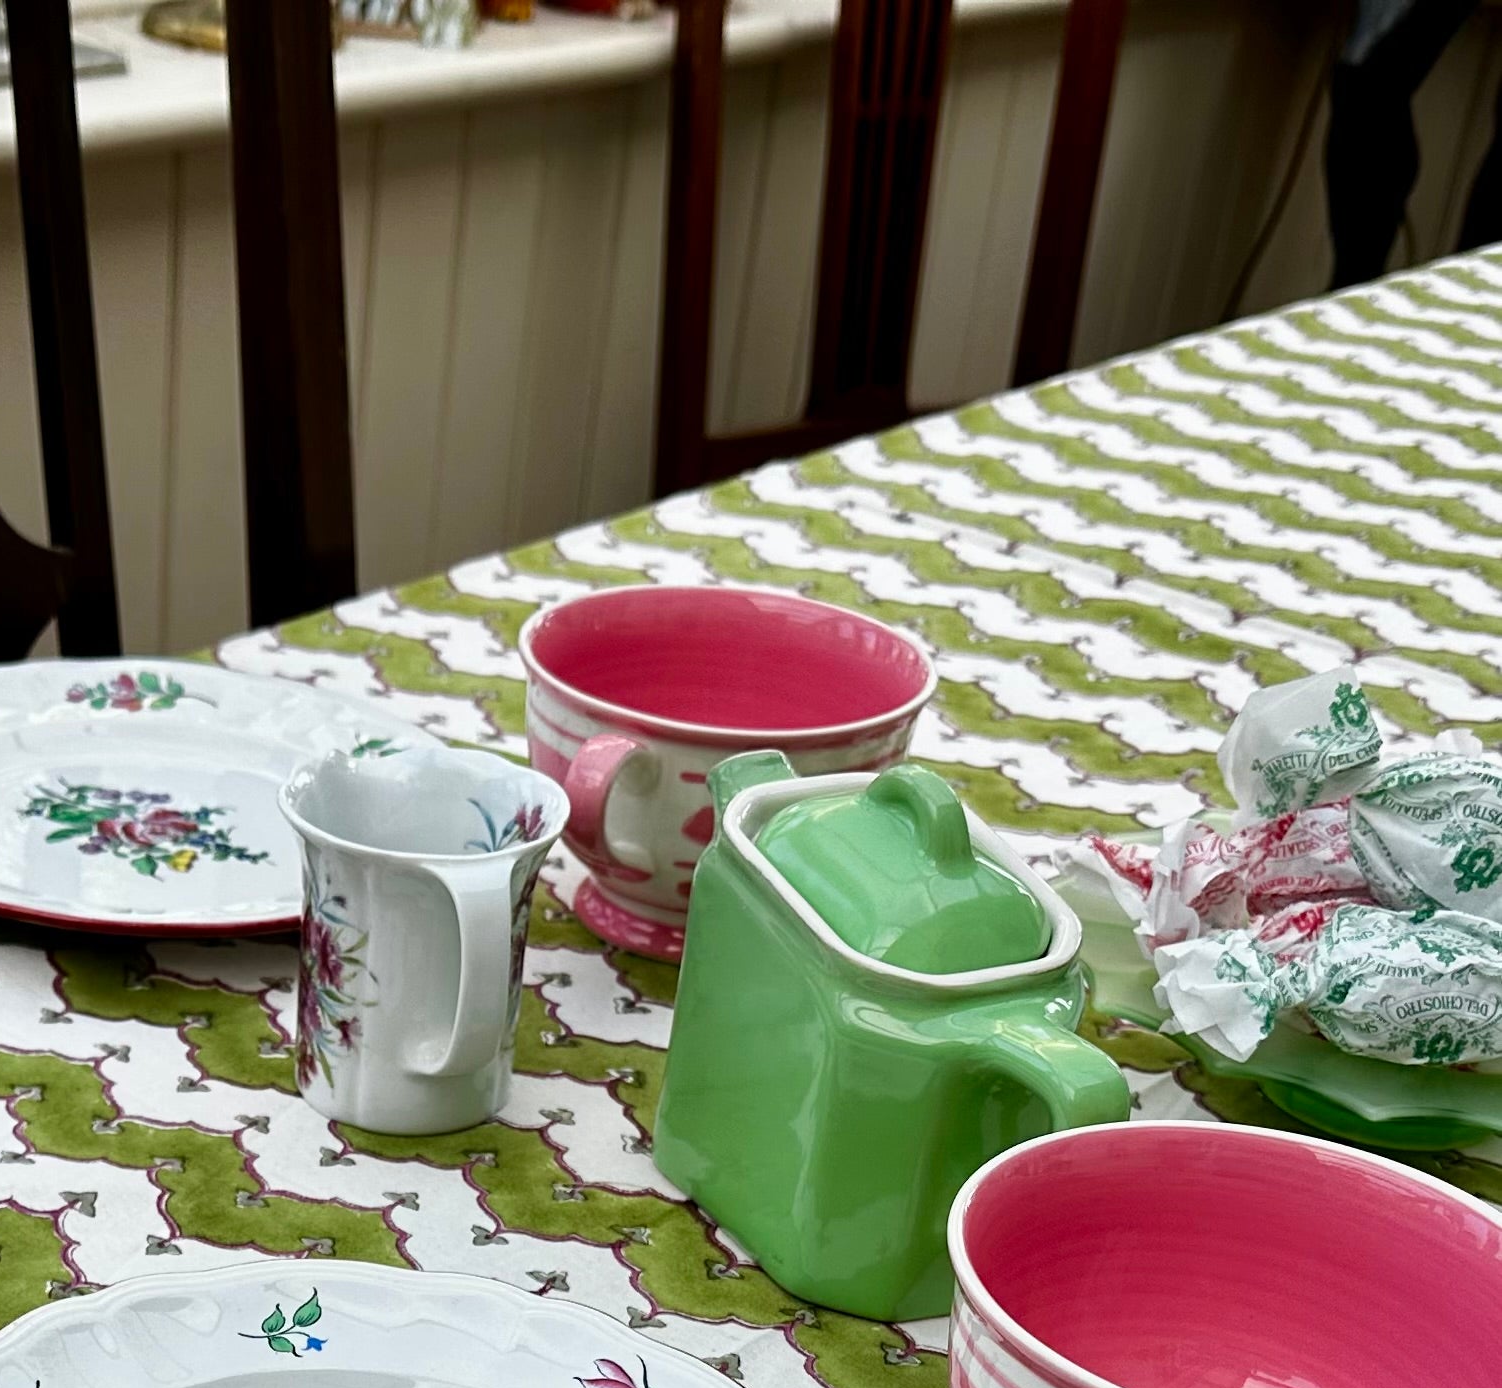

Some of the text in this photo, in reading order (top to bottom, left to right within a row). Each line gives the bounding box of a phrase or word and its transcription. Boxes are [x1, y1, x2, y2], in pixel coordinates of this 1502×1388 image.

[1328, 753, 1354, 768] DEL
[1374, 962, 1426, 978] AMARETTI
[1395, 995, 1464, 1020] CHIOSTRO
[1466, 999, 1490, 1018] DEL
